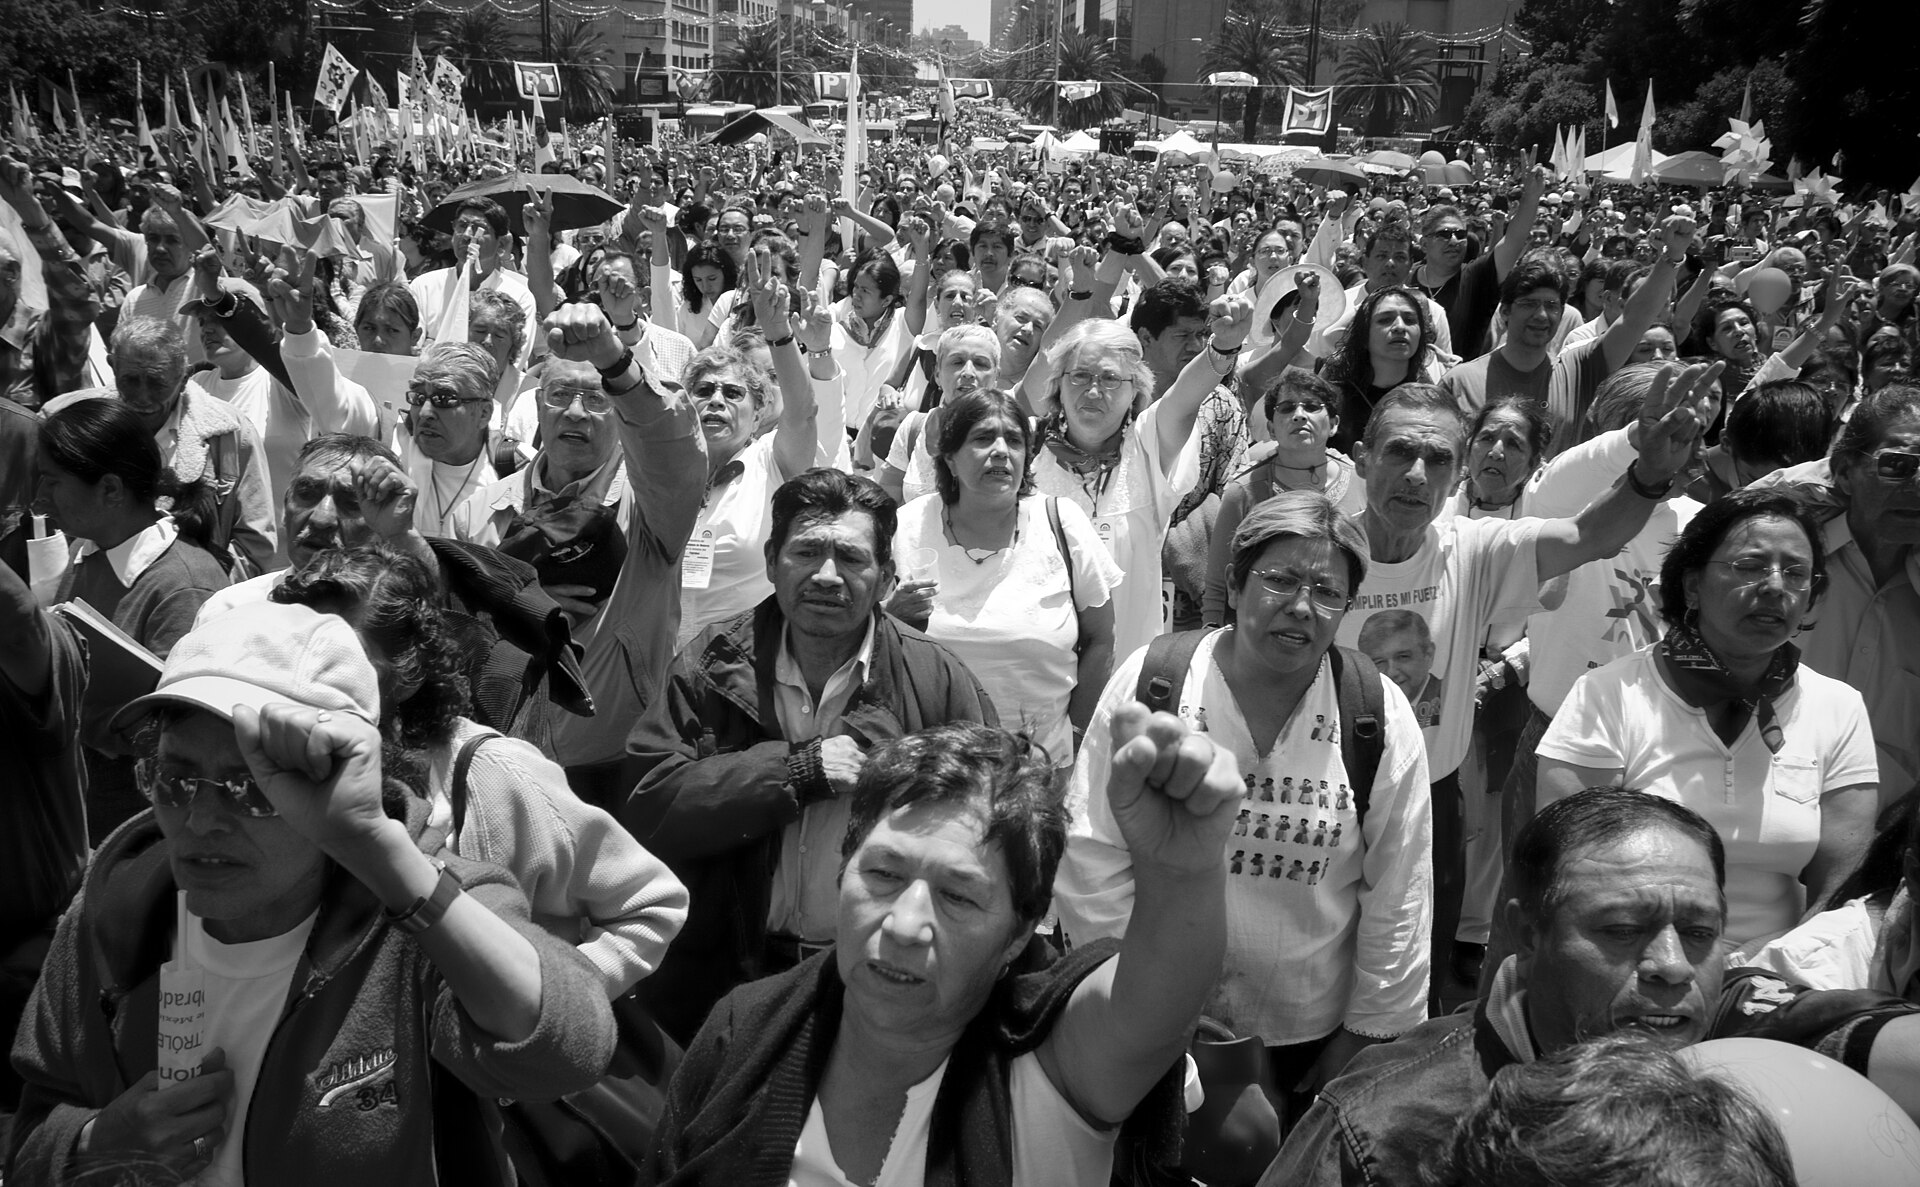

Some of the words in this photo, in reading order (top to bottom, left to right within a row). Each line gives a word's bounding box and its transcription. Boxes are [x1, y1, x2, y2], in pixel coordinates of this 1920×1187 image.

[523, 70, 555, 92] PT
[1290, 103, 1326, 128] PT
[1386, 593, 1399, 608] ES
[1400, 591, 1411, 605] MI
[357, 1082, 398, 1111] 34
